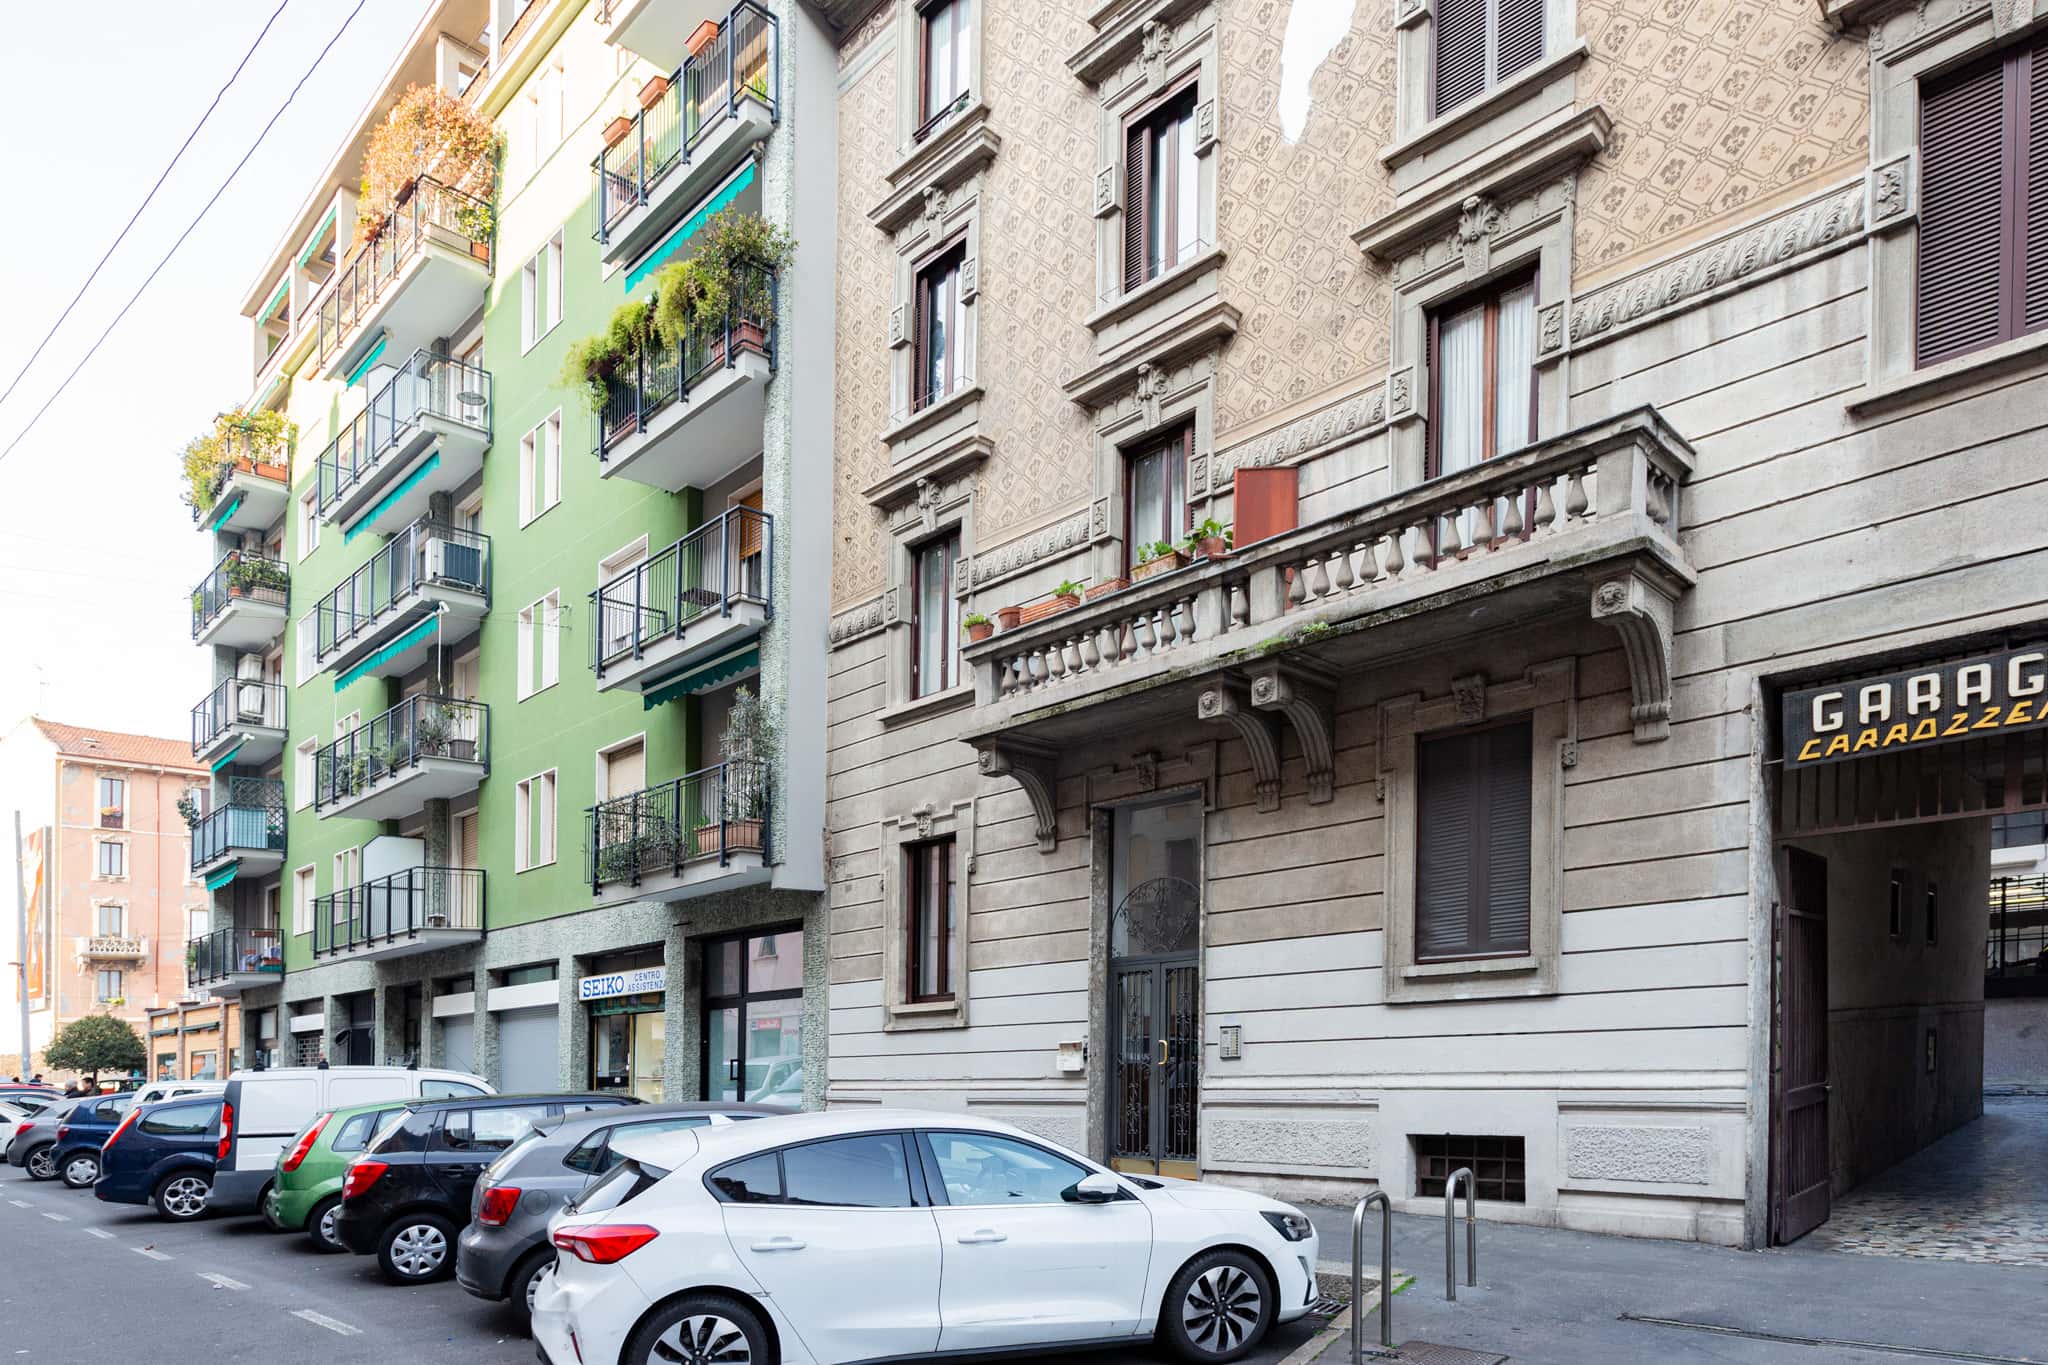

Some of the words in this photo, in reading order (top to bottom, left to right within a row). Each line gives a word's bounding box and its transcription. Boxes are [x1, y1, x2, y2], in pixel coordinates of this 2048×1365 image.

[1812, 652, 2045, 733] GARAG
[634, 970, 660, 981] CENTRO
[583, 976, 624, 997] SEIKO
